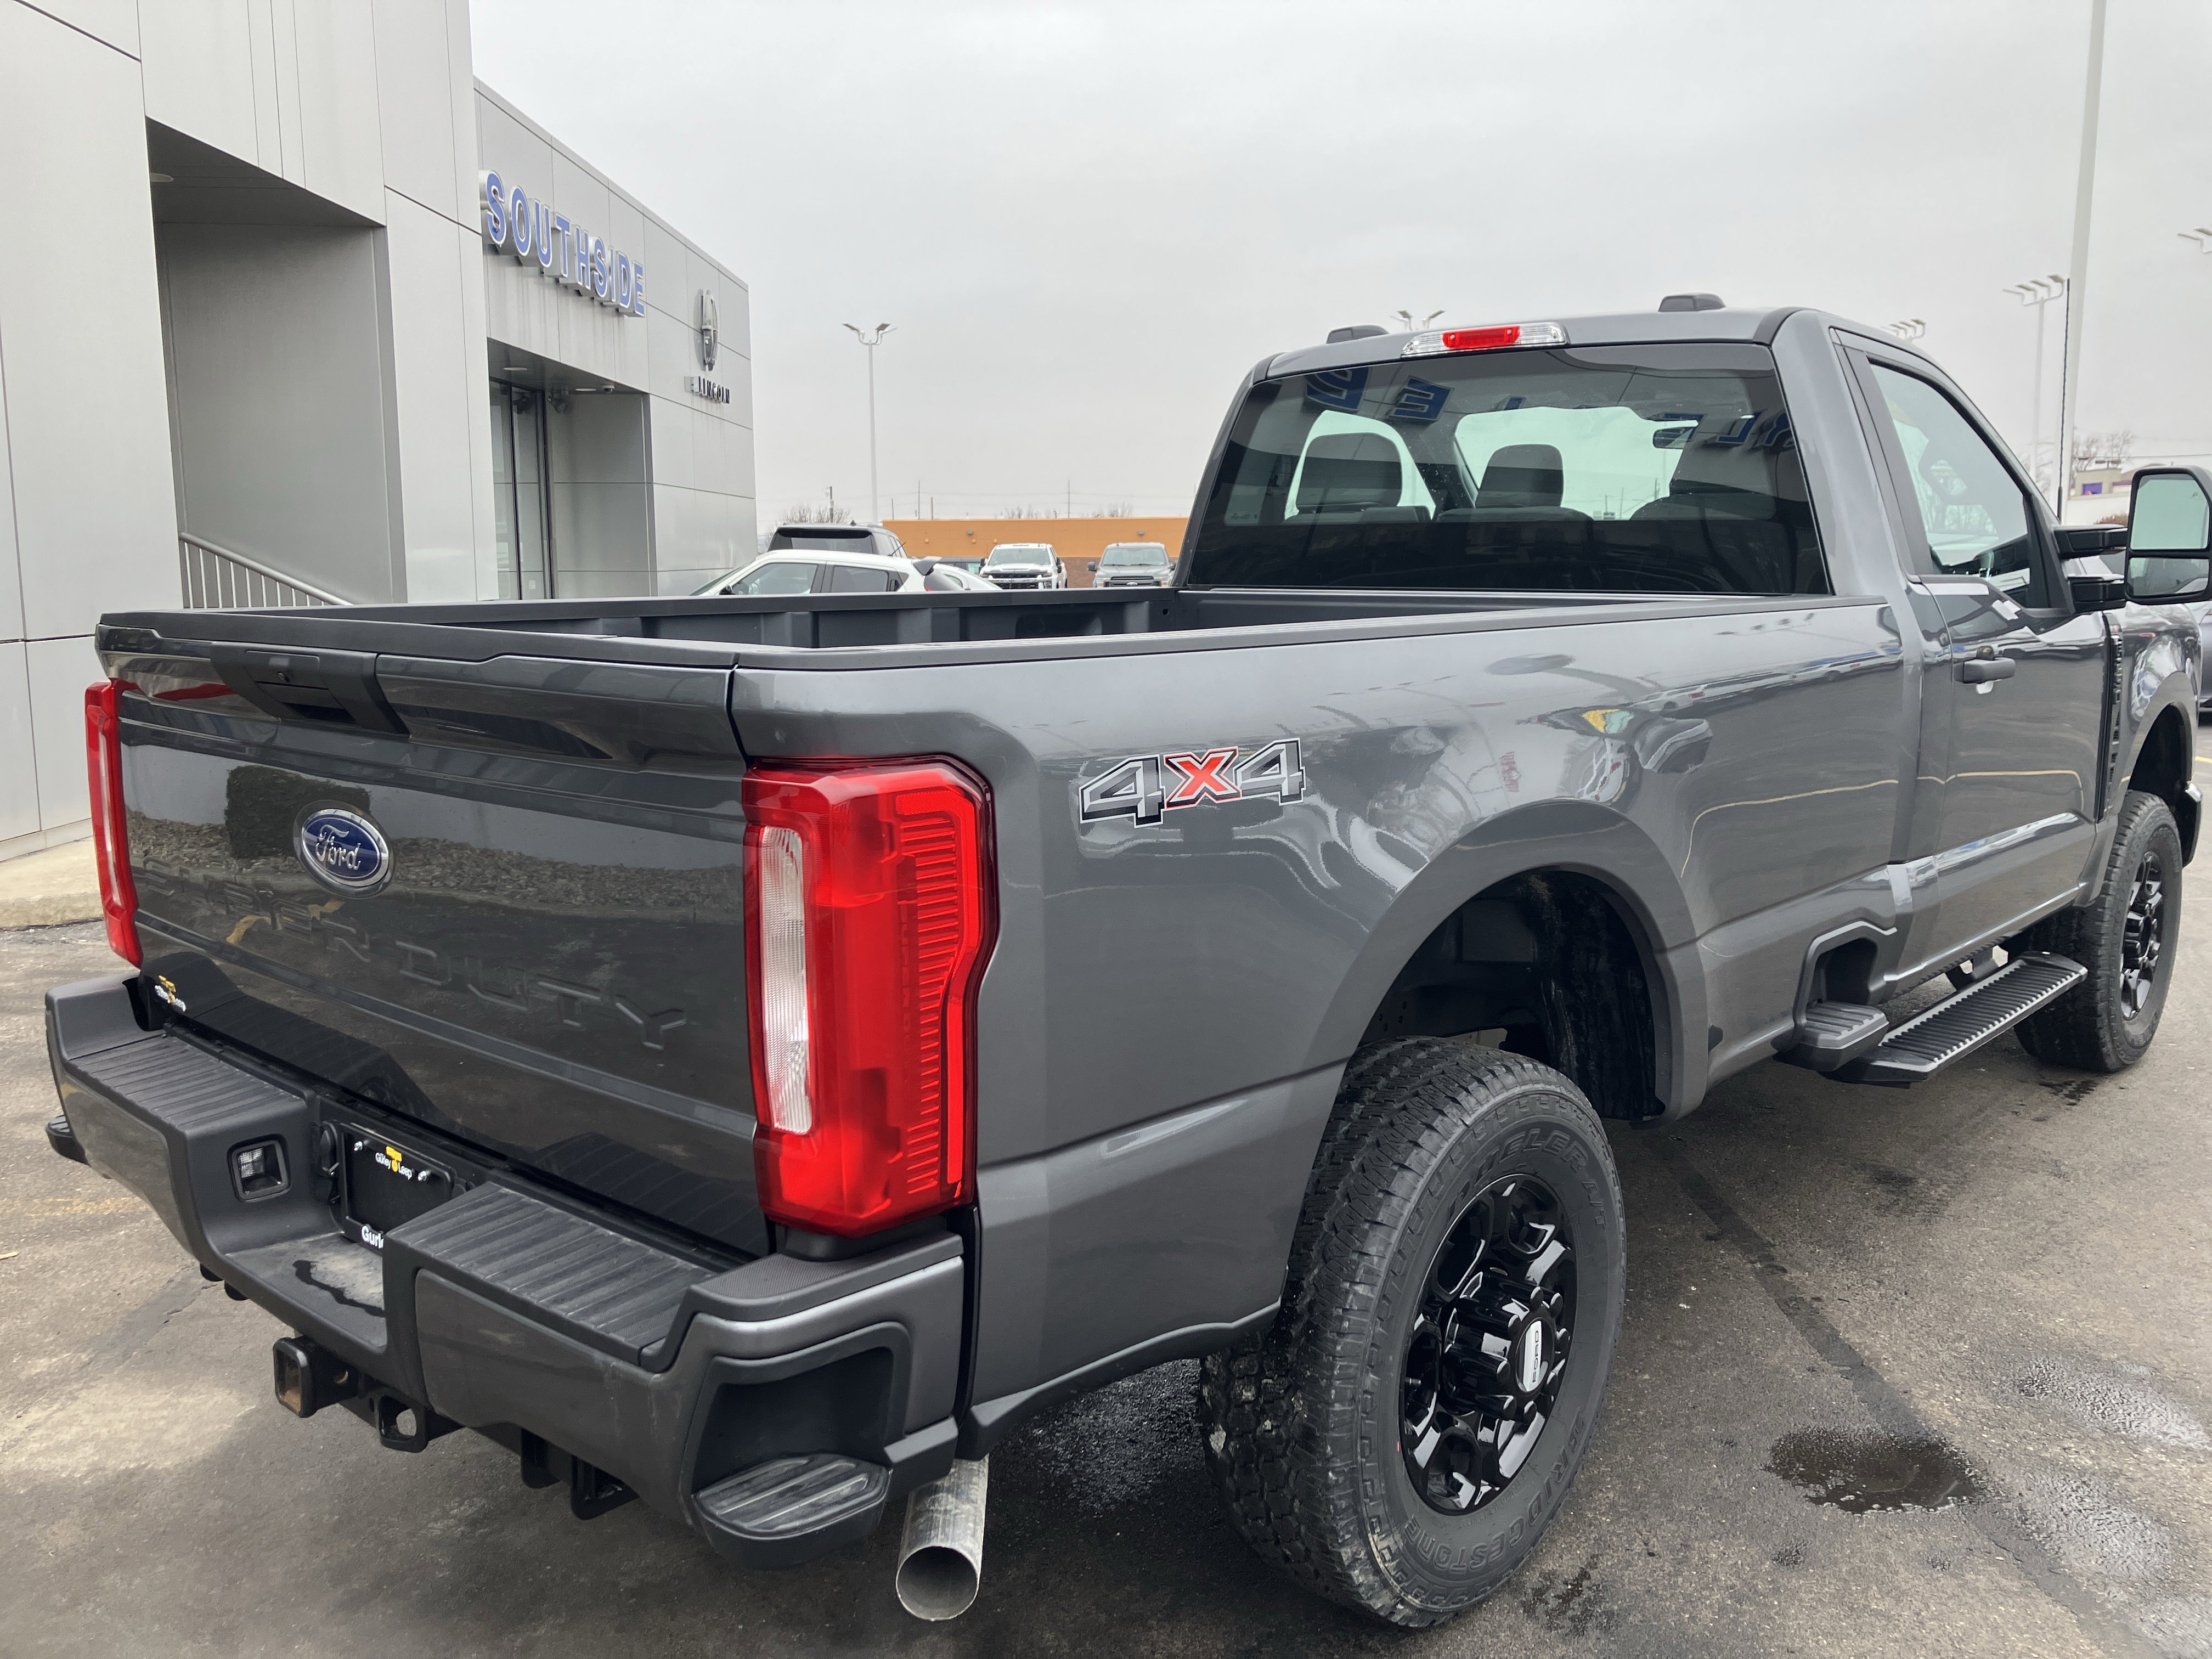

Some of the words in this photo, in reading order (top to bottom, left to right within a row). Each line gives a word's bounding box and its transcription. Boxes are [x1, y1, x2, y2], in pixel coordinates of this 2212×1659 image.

[486, 170, 645, 317] SOUTHSIDE
[697, 376, 730, 404] LINCOLN
[315, 825, 362, 870] Ford
[362, 1225, 383, 1249] Gurl
[1403, 1406, 1588, 1575] BRIDGESTONE
